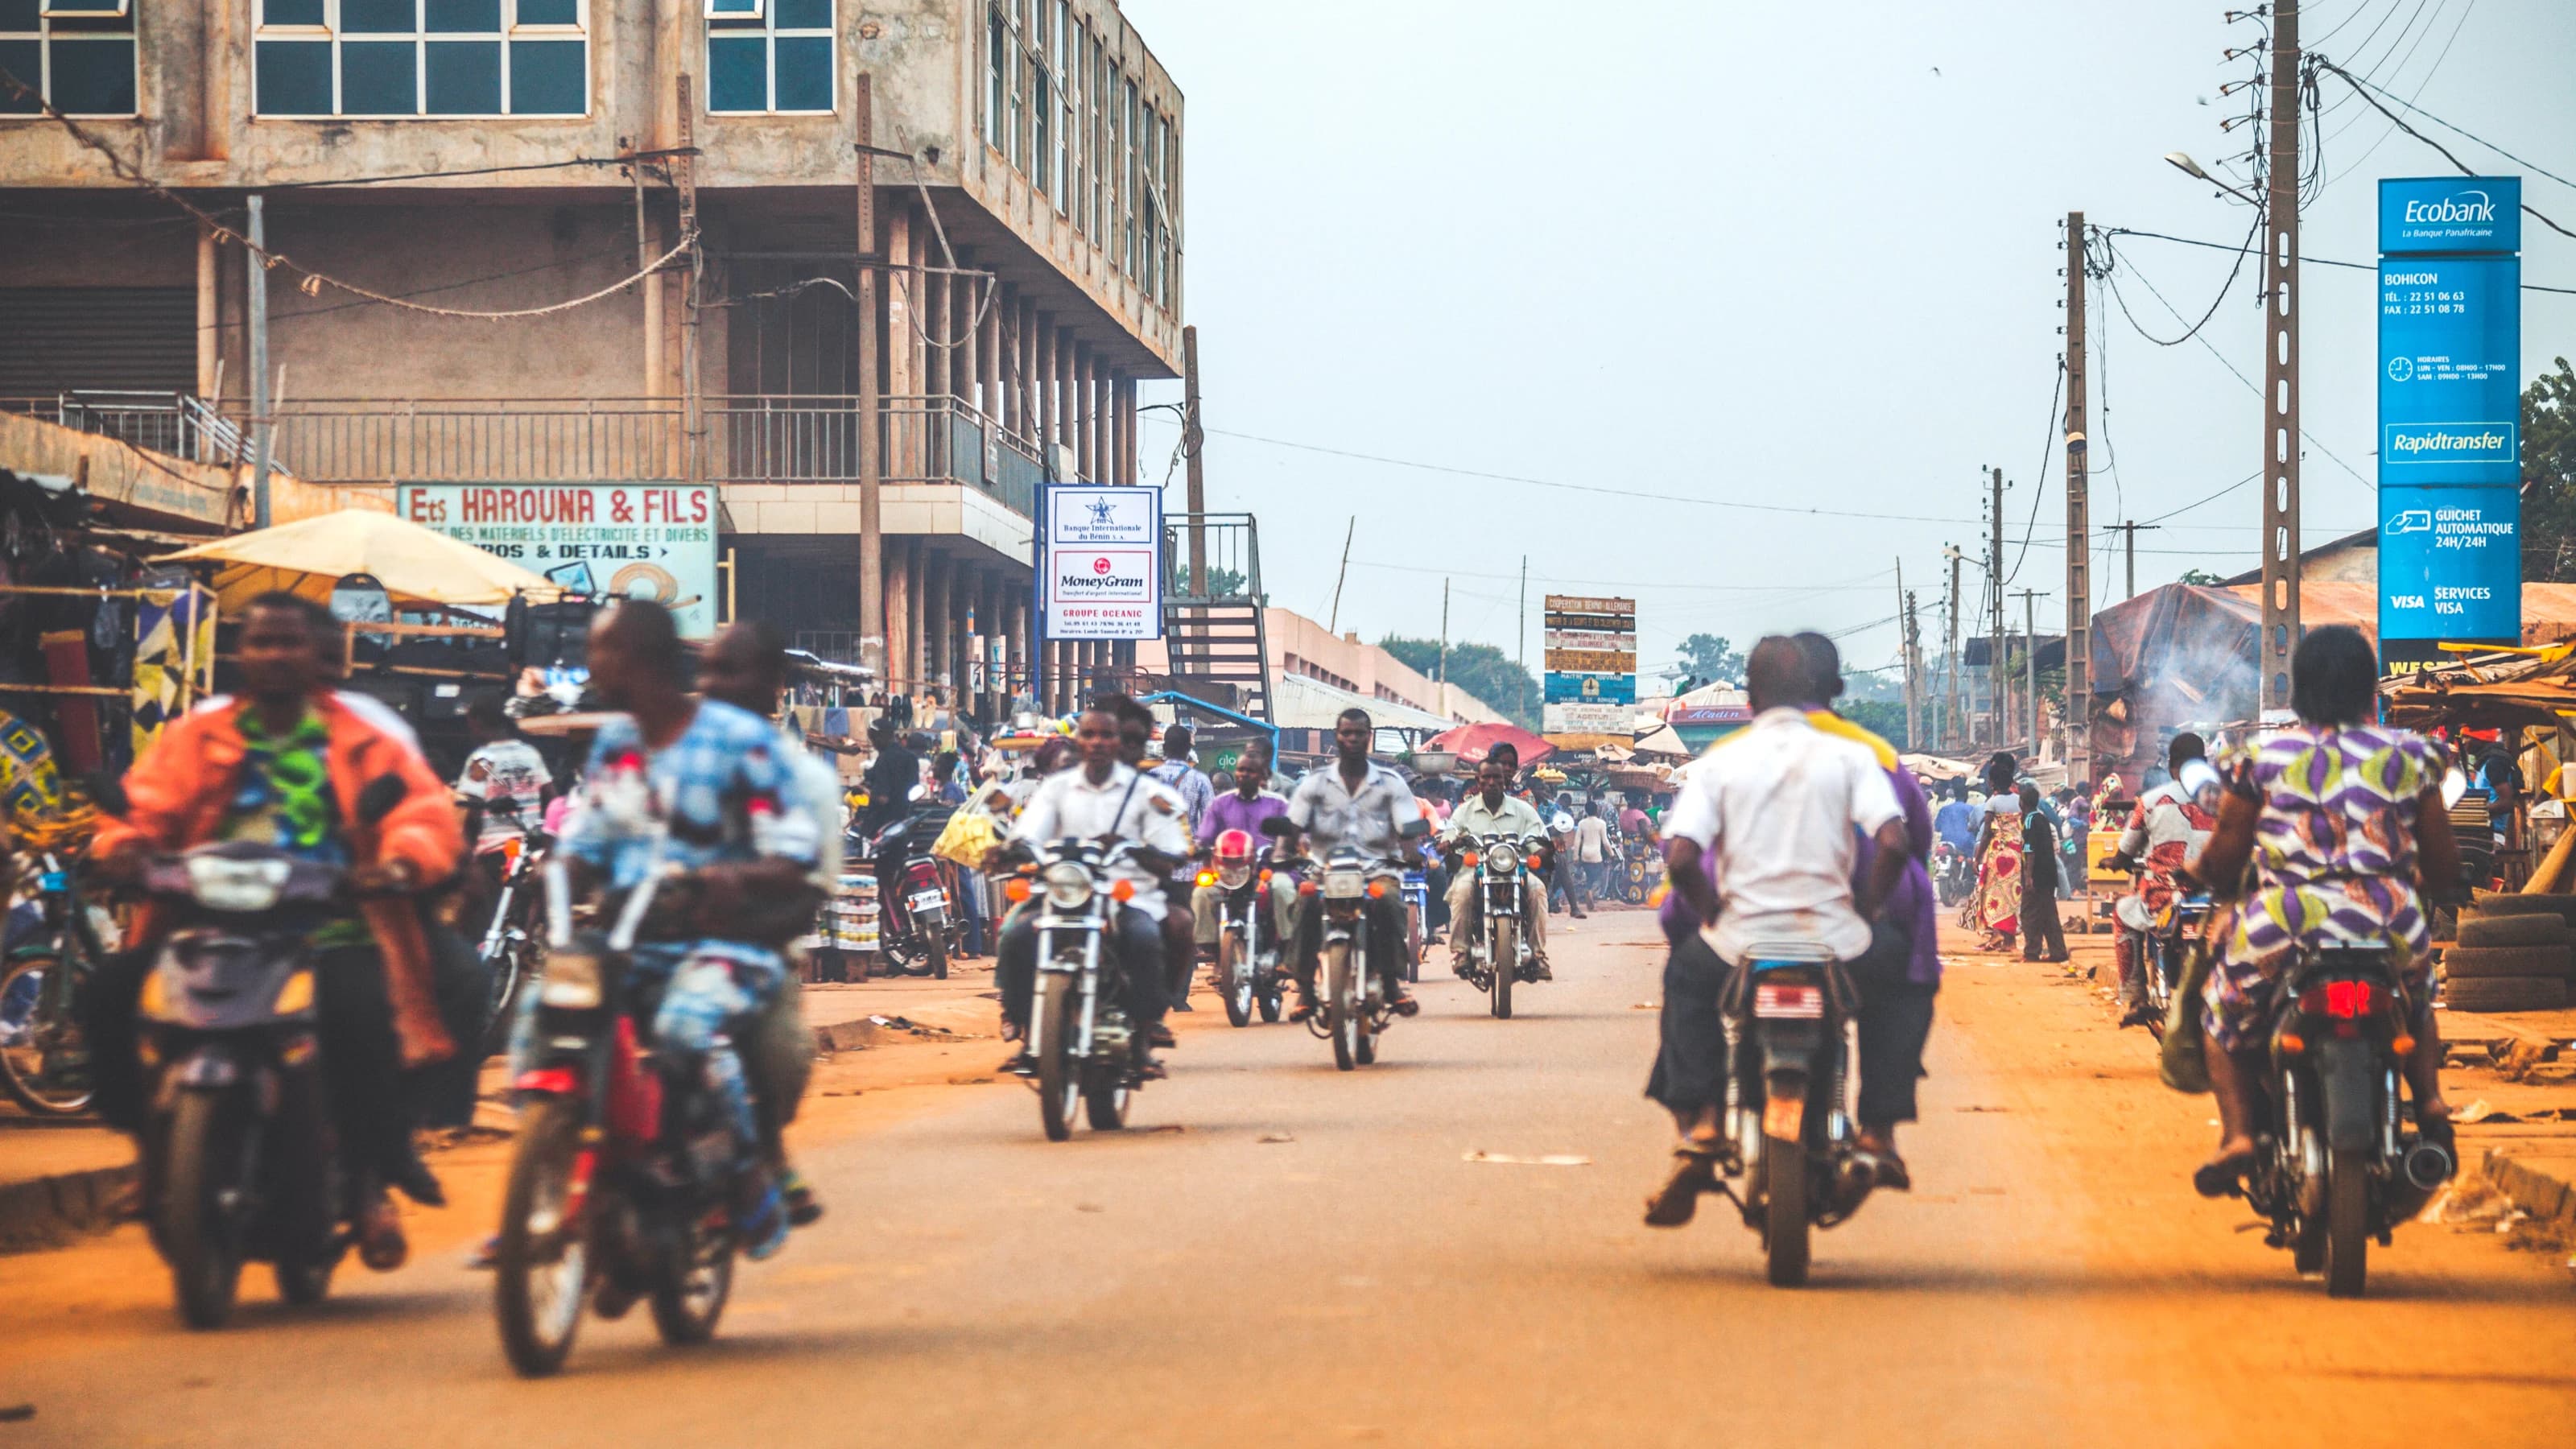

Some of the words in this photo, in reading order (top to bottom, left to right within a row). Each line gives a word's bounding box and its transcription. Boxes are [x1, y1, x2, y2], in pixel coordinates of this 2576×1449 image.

[2405, 191, 2496, 222] Ecobank
[2413, 229, 2442, 238] Banque
[2446, 228, 2492, 237] Panafricaine
[2384, 273, 2438, 285] BOHICON
[2384, 291, 2401, 302] TÉL.
[2410, 292, 2421, 301] 22
[2424, 292, 2434, 301] 51
[2438, 292, 2450, 301] 06
[2453, 291, 2464, 301] 63
[2384, 305, 2401, 315] FAX
[2410, 305, 2421, 314] 22
[2424, 305, 2434, 314] 51
[2438, 304, 2450, 314] 08
[2453, 303, 2464, 313] 78
[2394, 431, 2505, 454] Rapidtransfer
[410, 489, 446, 522] Ets
[462, 489, 594, 523] HAROUNA
[611, 489, 634, 523] &
[643, 489, 708, 523] FILS
[2435, 510, 2481, 522] GUICHET
[451, 527, 473, 541] DES
[479, 527, 546, 542] MATERIELS
[551, 527, 638, 542] D'ELECTRICITE
[644, 528, 659, 542] ET
[665, 528, 709, 543] DIVERS
[1064, 525, 1090, 533] Banque
[2435, 523, 2513, 536] AUTOMATIQUE
[2435, 535, 2487, 550] 24H/24H
[537, 545, 551, 558] &
[559, 544, 650, 559] DETAILS
[1062, 576, 1143, 589] MoneyGram
[2434, 586, 2491, 600] SERVICES
[2390, 596, 2425, 609] VISA
[2434, 601, 2464, 614] VISA
[1063, 609, 1098, 617] GROUPE
[1219, 754, 1236, 770] glo
